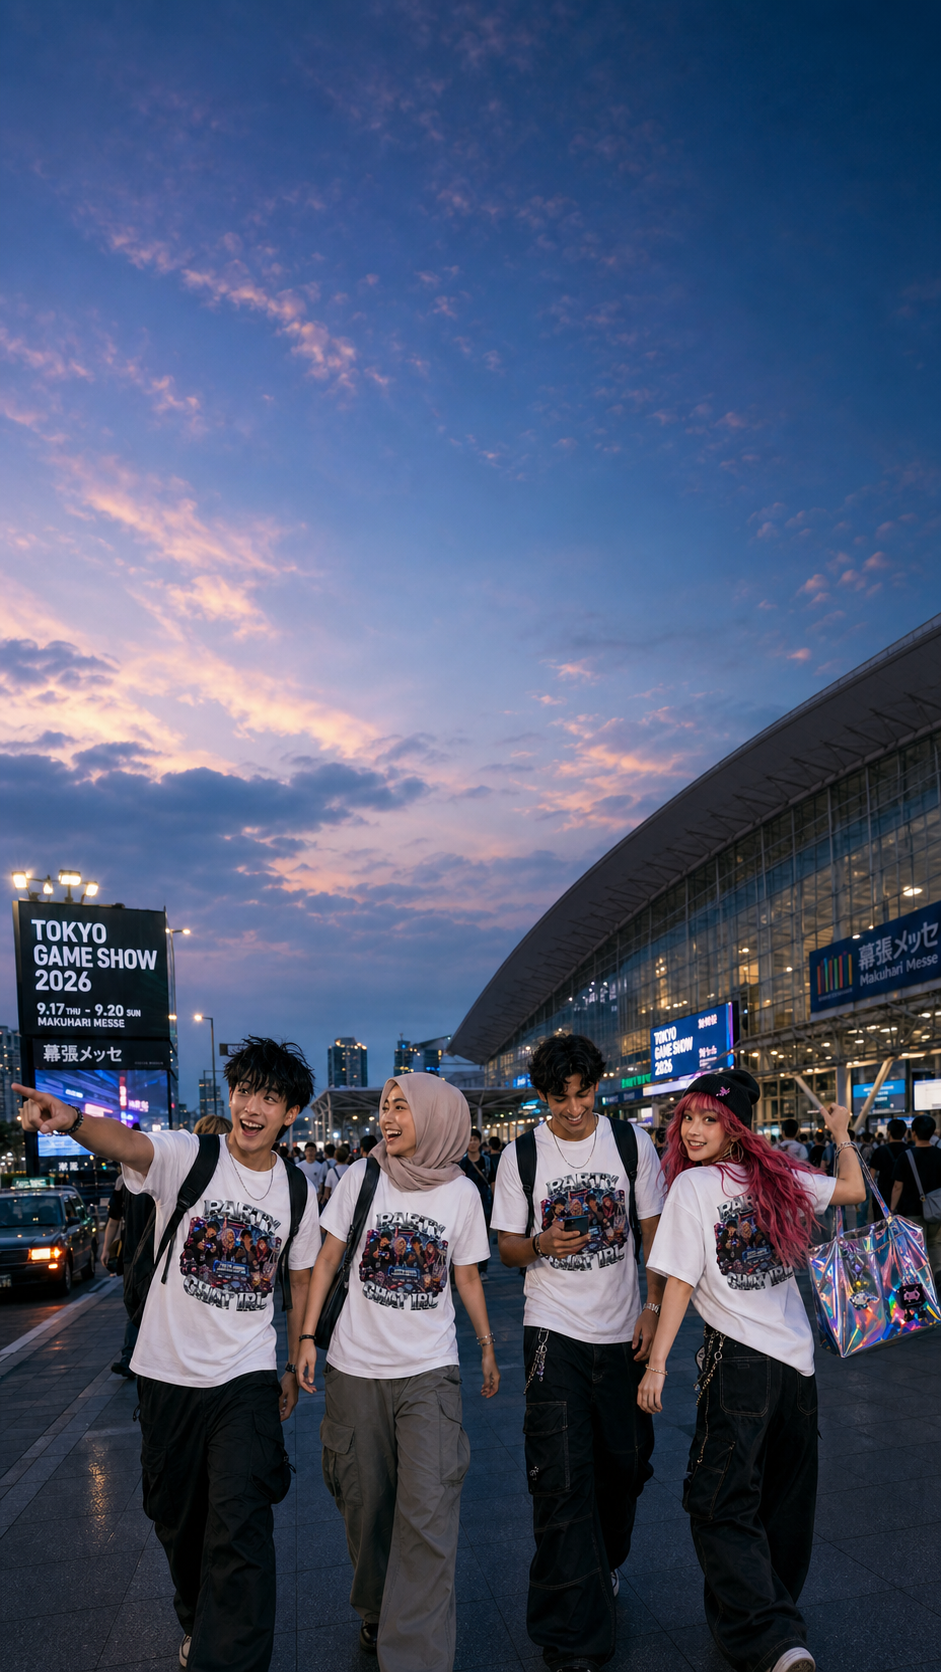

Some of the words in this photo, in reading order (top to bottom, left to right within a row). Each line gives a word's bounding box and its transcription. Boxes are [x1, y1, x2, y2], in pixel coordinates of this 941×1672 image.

[31, 919, 107, 944] TOKYO
[33, 944, 94, 968] GAME
[97, 948, 157, 970] SHOW
[858, 921, 939, 971] 幕張メッセ
[35, 969, 92, 992] 2026
[860, 961, 903, 986] Makuhari
[906, 954, 938, 972] Messe
[37, 1002, 65, 1015] 9.17
[66, 1007, 81, 1015] THU
[95, 1003, 124, 1017] 9.20
[126, 1009, 141, 1017] SUN
[38, 1017, 91, 1027] MAKUHARI
[94, 1018, 125, 1028] MESSE
[43, 1044, 122, 1062] 幕張メッセ
[546, 1172, 619, 1194] PARTY
[204, 1200, 281, 1236] PARTY
[717, 1194, 756, 1220] PAR
[376, 1212, 446, 1239] PARTY
